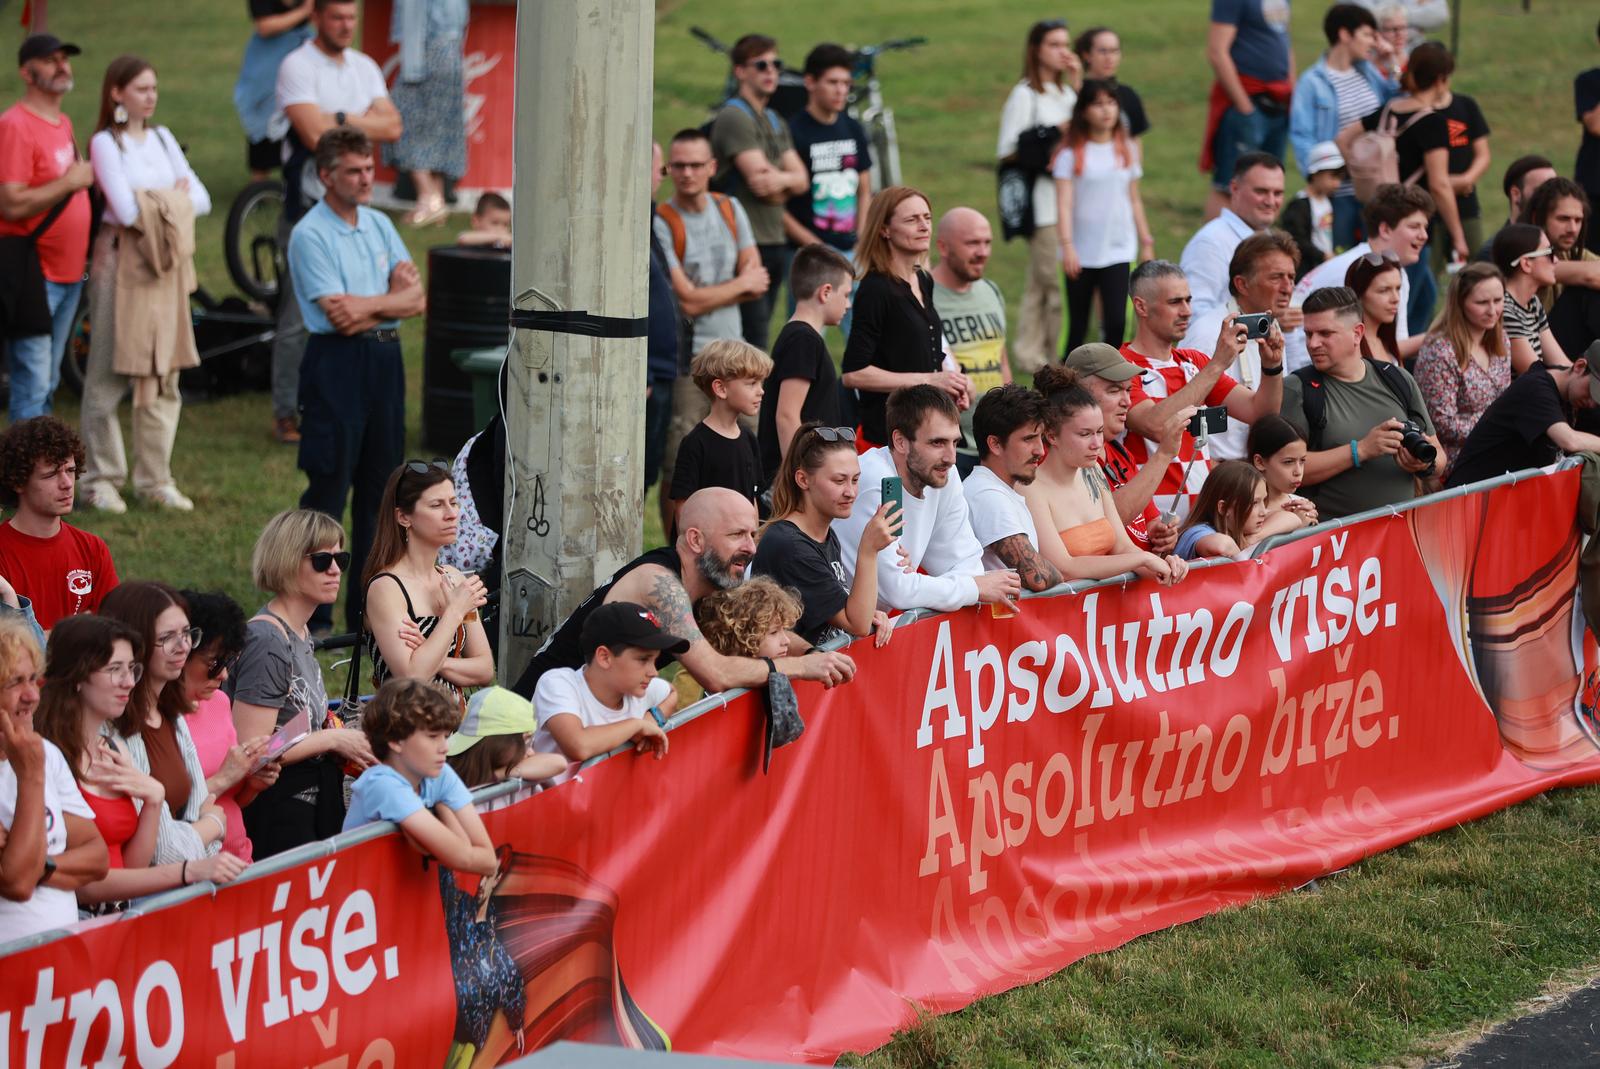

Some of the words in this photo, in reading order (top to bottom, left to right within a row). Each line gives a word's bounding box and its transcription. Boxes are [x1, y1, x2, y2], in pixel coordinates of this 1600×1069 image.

[941, 312, 1004, 345] BERLIN
[917, 592, 1254, 768] Apsolutno
[1269, 531, 1397, 662] više.
[919, 711, 1251, 894] Apsolutno
[1260, 645, 1399, 776] brže.
[211, 859, 399, 1043] više.
